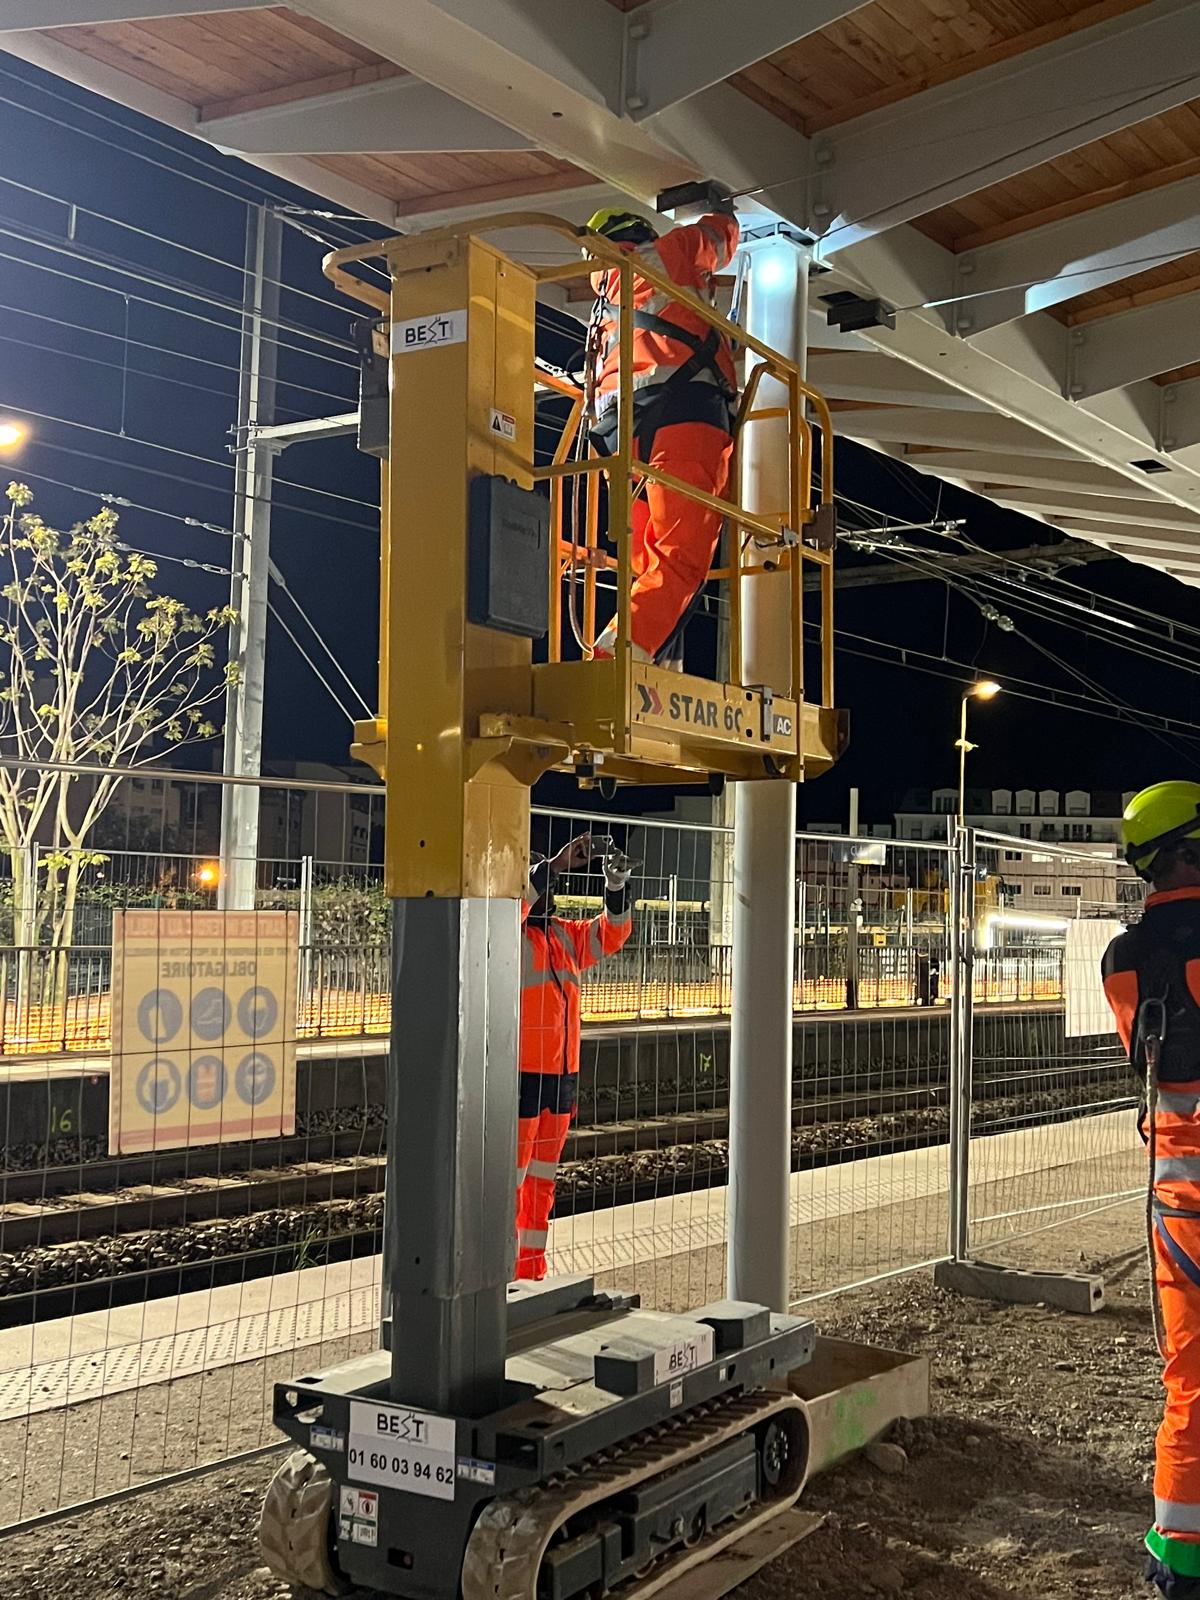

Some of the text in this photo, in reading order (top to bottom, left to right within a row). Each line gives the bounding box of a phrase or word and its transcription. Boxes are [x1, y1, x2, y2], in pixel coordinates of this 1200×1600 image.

[405, 317, 450, 344] BEST
[669, 692, 718, 729] STAR
[776, 717, 792, 735] AC
[51, 1106, 72, 1133] 16
[377, 1413, 424, 1441] BEST
[349, 1449, 453, 1484] 01 60 03 94 62
